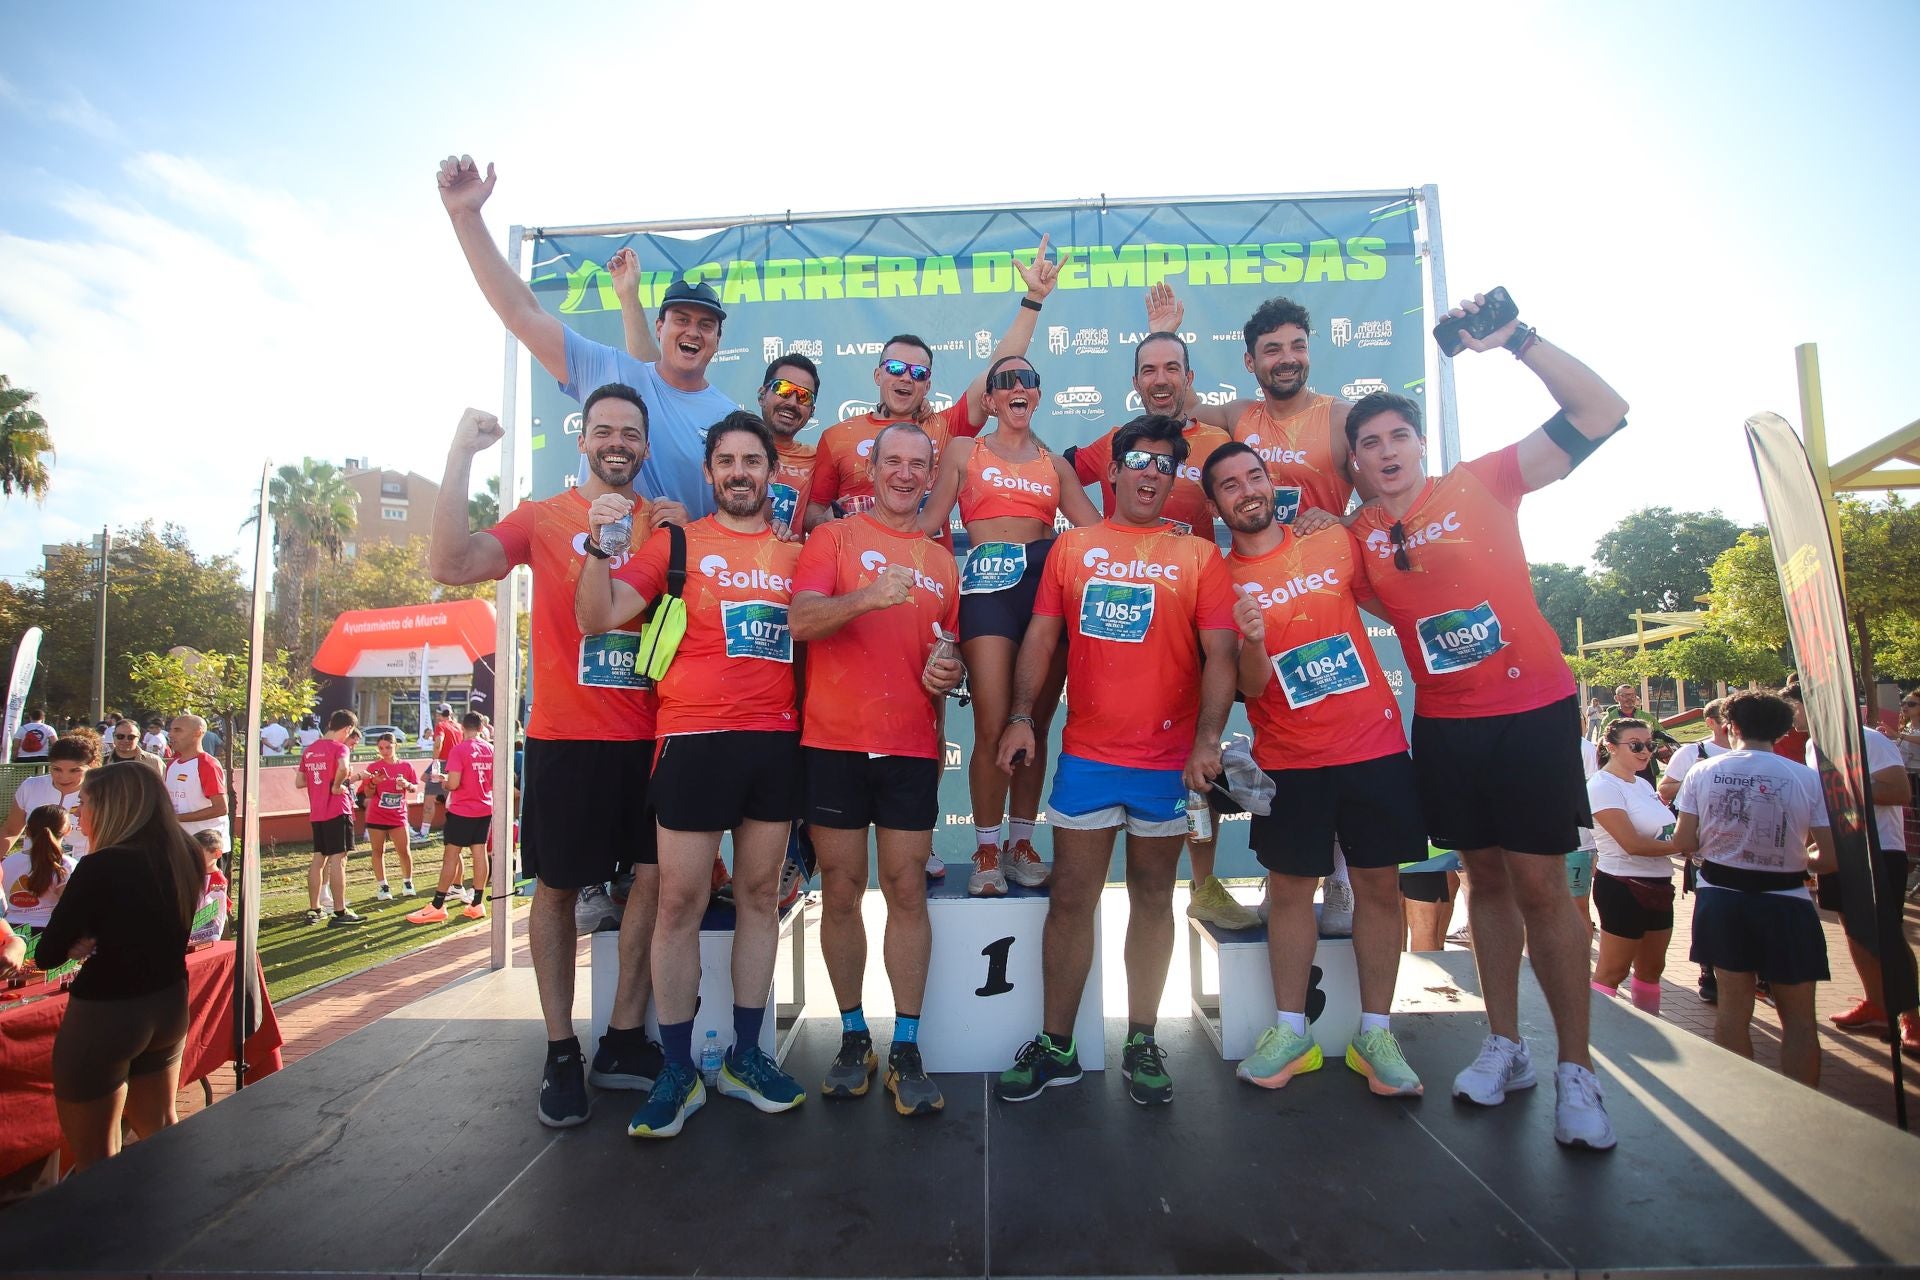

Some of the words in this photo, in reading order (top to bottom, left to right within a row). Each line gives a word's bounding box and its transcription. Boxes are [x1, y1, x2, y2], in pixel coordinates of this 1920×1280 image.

[683, 254, 962, 306] CARRERA
[1054, 236, 1387, 291] EMPRESAS
[1119, 332, 1137, 344] LA
[1137, 332, 1197, 344] VAD
[1353, 331, 1393, 339] ATLETISMO
[836, 344, 856, 356] LA
[855, 343, 885, 355] VER
[1257, 446, 1307, 465] oltec
[993, 475, 1052, 498] soltec
[773, 496, 789, 513] 74
[972, 557, 1016, 574] 1078
[1096, 560, 1180, 582] soltec
[1257, 567, 1340, 610] soltec
[1095, 600, 1142, 622] 1085
[342, 618, 401, 636] Ayuntamiento
[402, 616, 415, 628] de
[738, 620, 782, 640] 1077
[1434, 623, 1489, 650] 1080
[596, 649, 638, 669] 108
[1294, 652, 1348, 682] 1084
[1713, 774, 1754, 787] bionet
[975, 936, 1016, 997] 1
